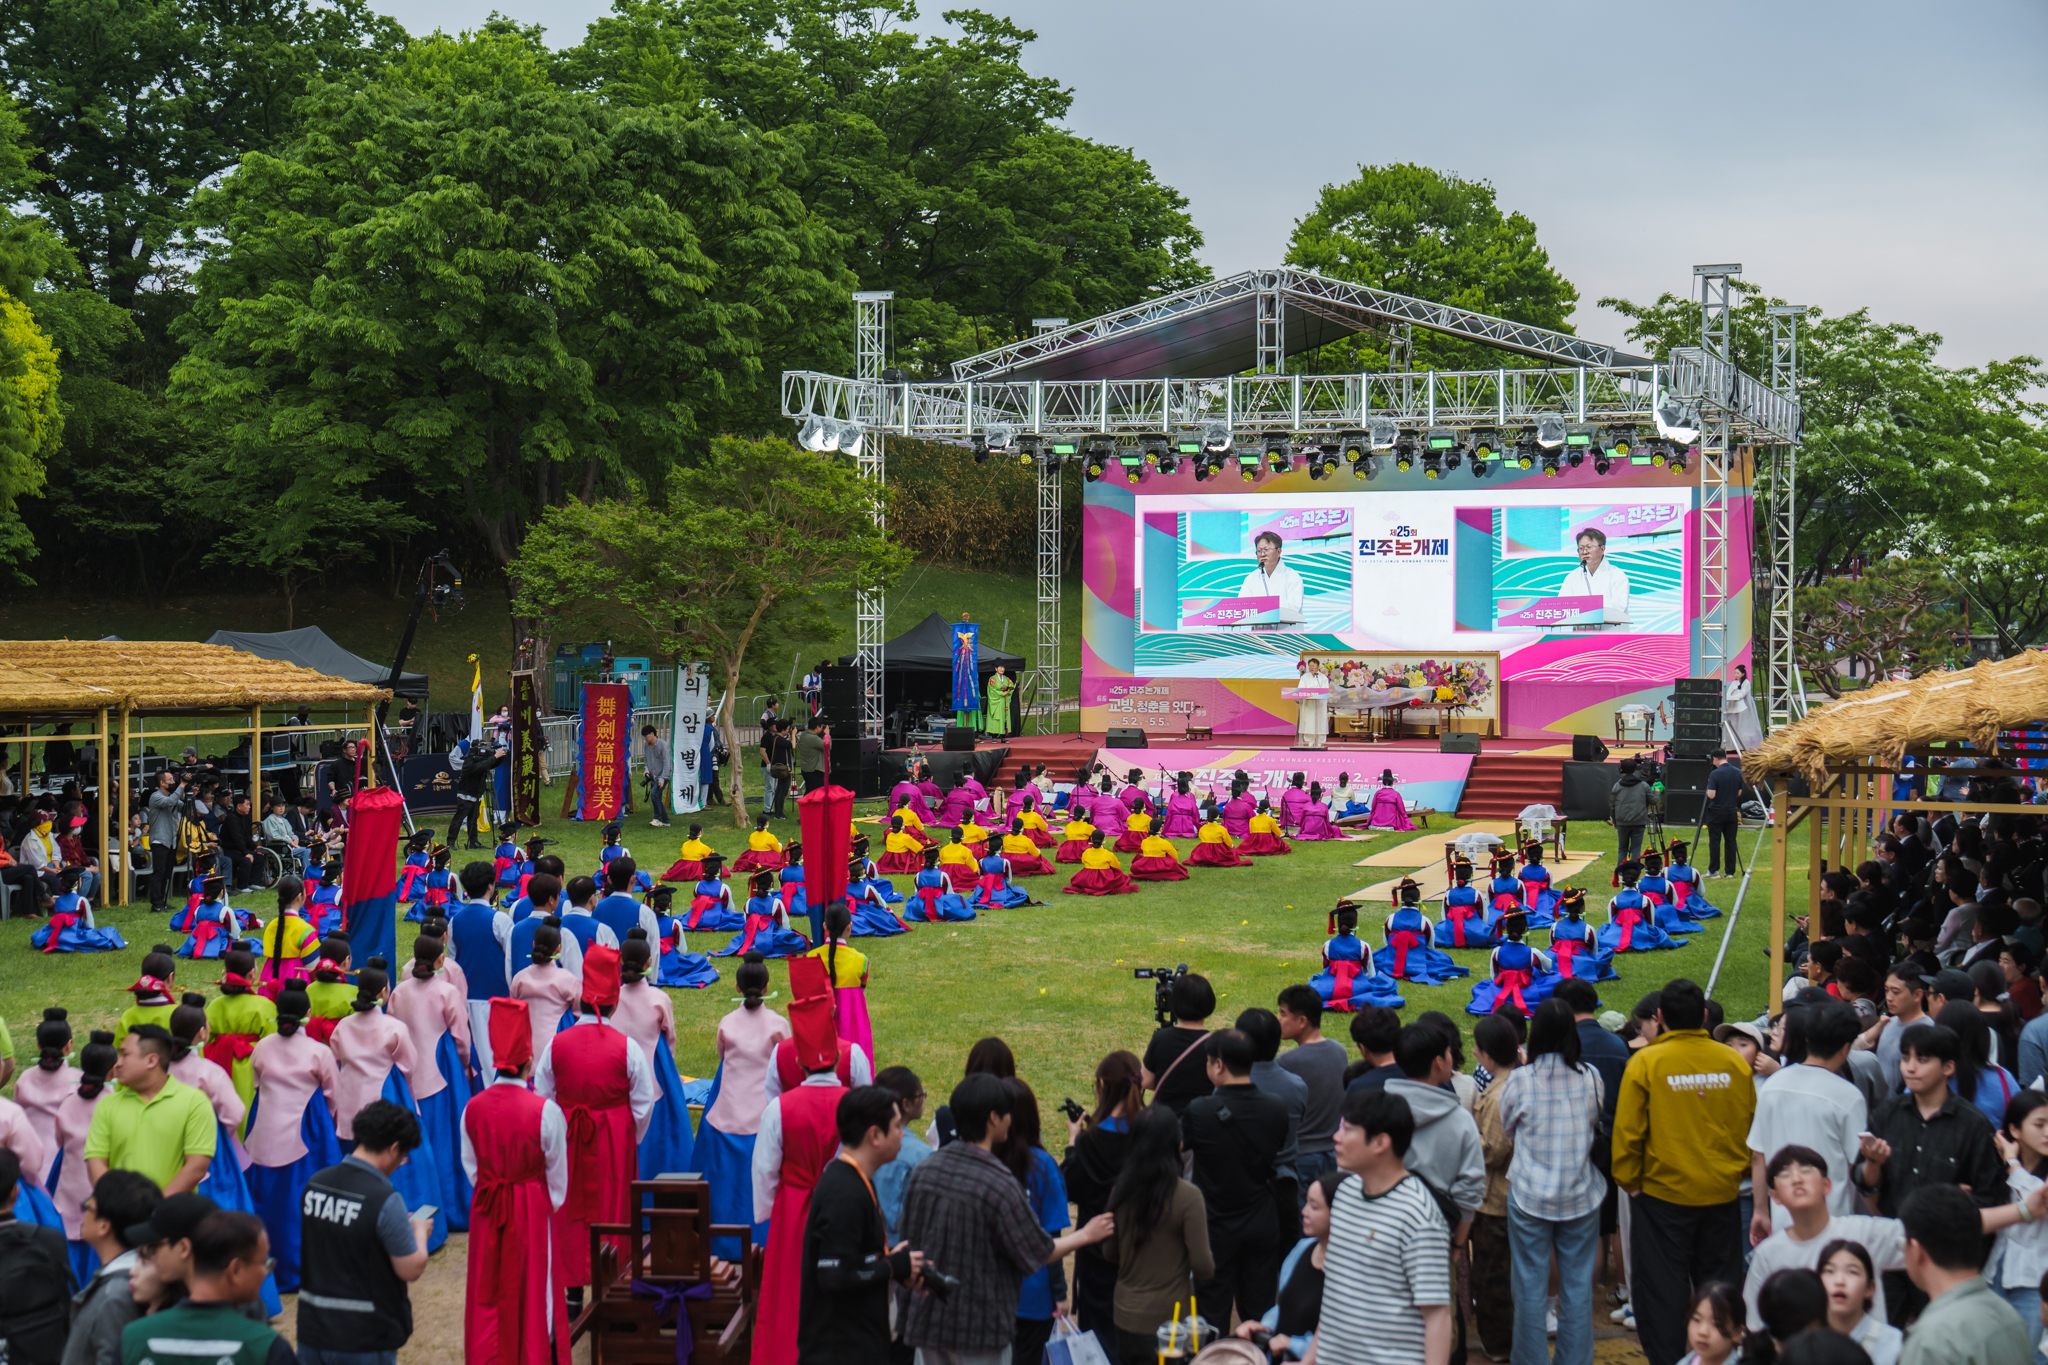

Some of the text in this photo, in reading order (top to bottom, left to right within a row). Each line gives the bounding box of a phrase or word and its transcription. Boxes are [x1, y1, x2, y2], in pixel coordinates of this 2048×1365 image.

[1389, 525, 1418, 537] 제25회
[1358, 538, 1449, 556] 진주논개제
[1217, 608, 1258, 619] 진주논개제
[1535, 608, 1580, 620] 진주논개제
[1108, 686, 1170, 695] 제25회 진주논개제
[1172, 701, 1195, 714] 잇다
[679, 676, 701, 805] 의암별제
[1666, 1072, 1732, 1086] UMBRO
[303, 1189, 363, 1227] STAFF
